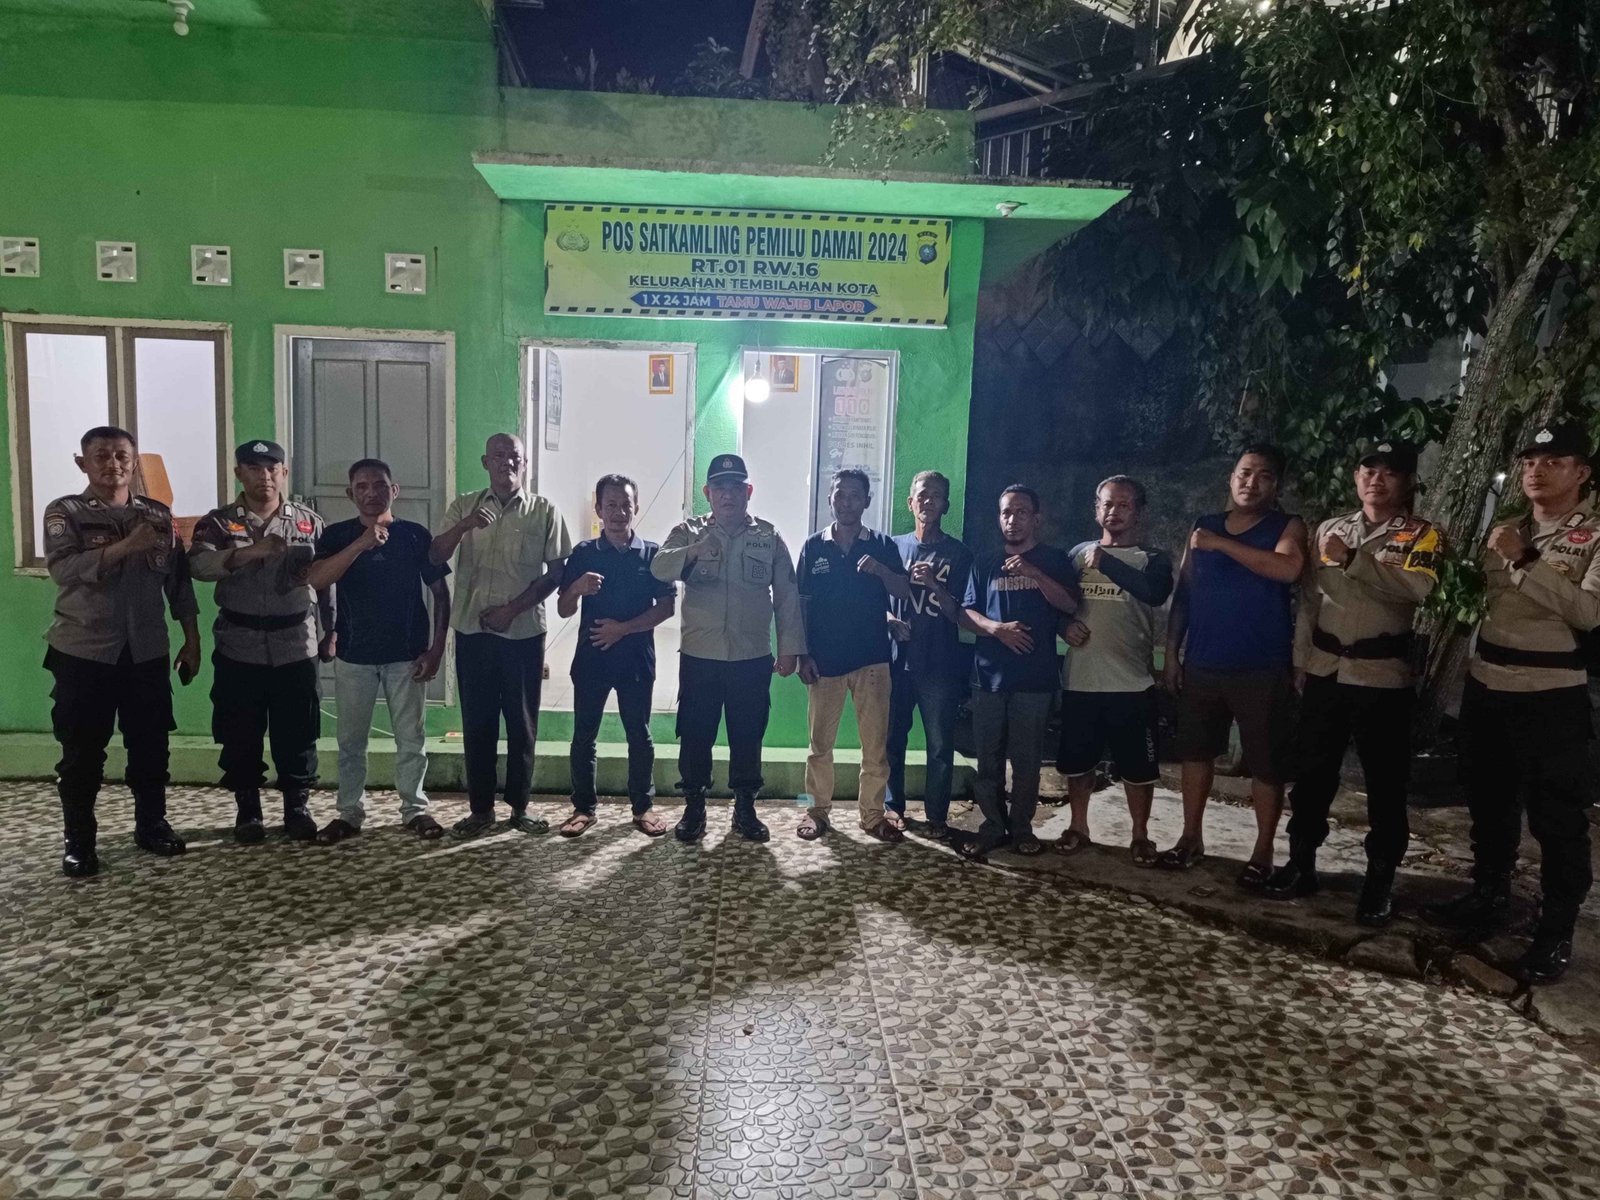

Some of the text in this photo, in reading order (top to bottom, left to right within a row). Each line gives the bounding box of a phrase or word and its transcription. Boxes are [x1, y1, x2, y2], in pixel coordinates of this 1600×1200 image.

[602, 221, 908, 262] POS SATKAMLING PEMILU DAMAI 2024
[691, 258, 819, 276] RT.01 RW.16
[629, 274, 879, 295] KELURAHAN TEMBILAHAN KOTA
[664, 295, 680, 306] 24
[683, 295, 711, 307] JAM
[717, 296, 760, 309] TAMU
[763, 297, 811, 310] WAJIB
[815, 300, 865, 312] LAPOR
[746, 541, 772, 550] POLRI
[1551, 543, 1587, 558] POLRI
